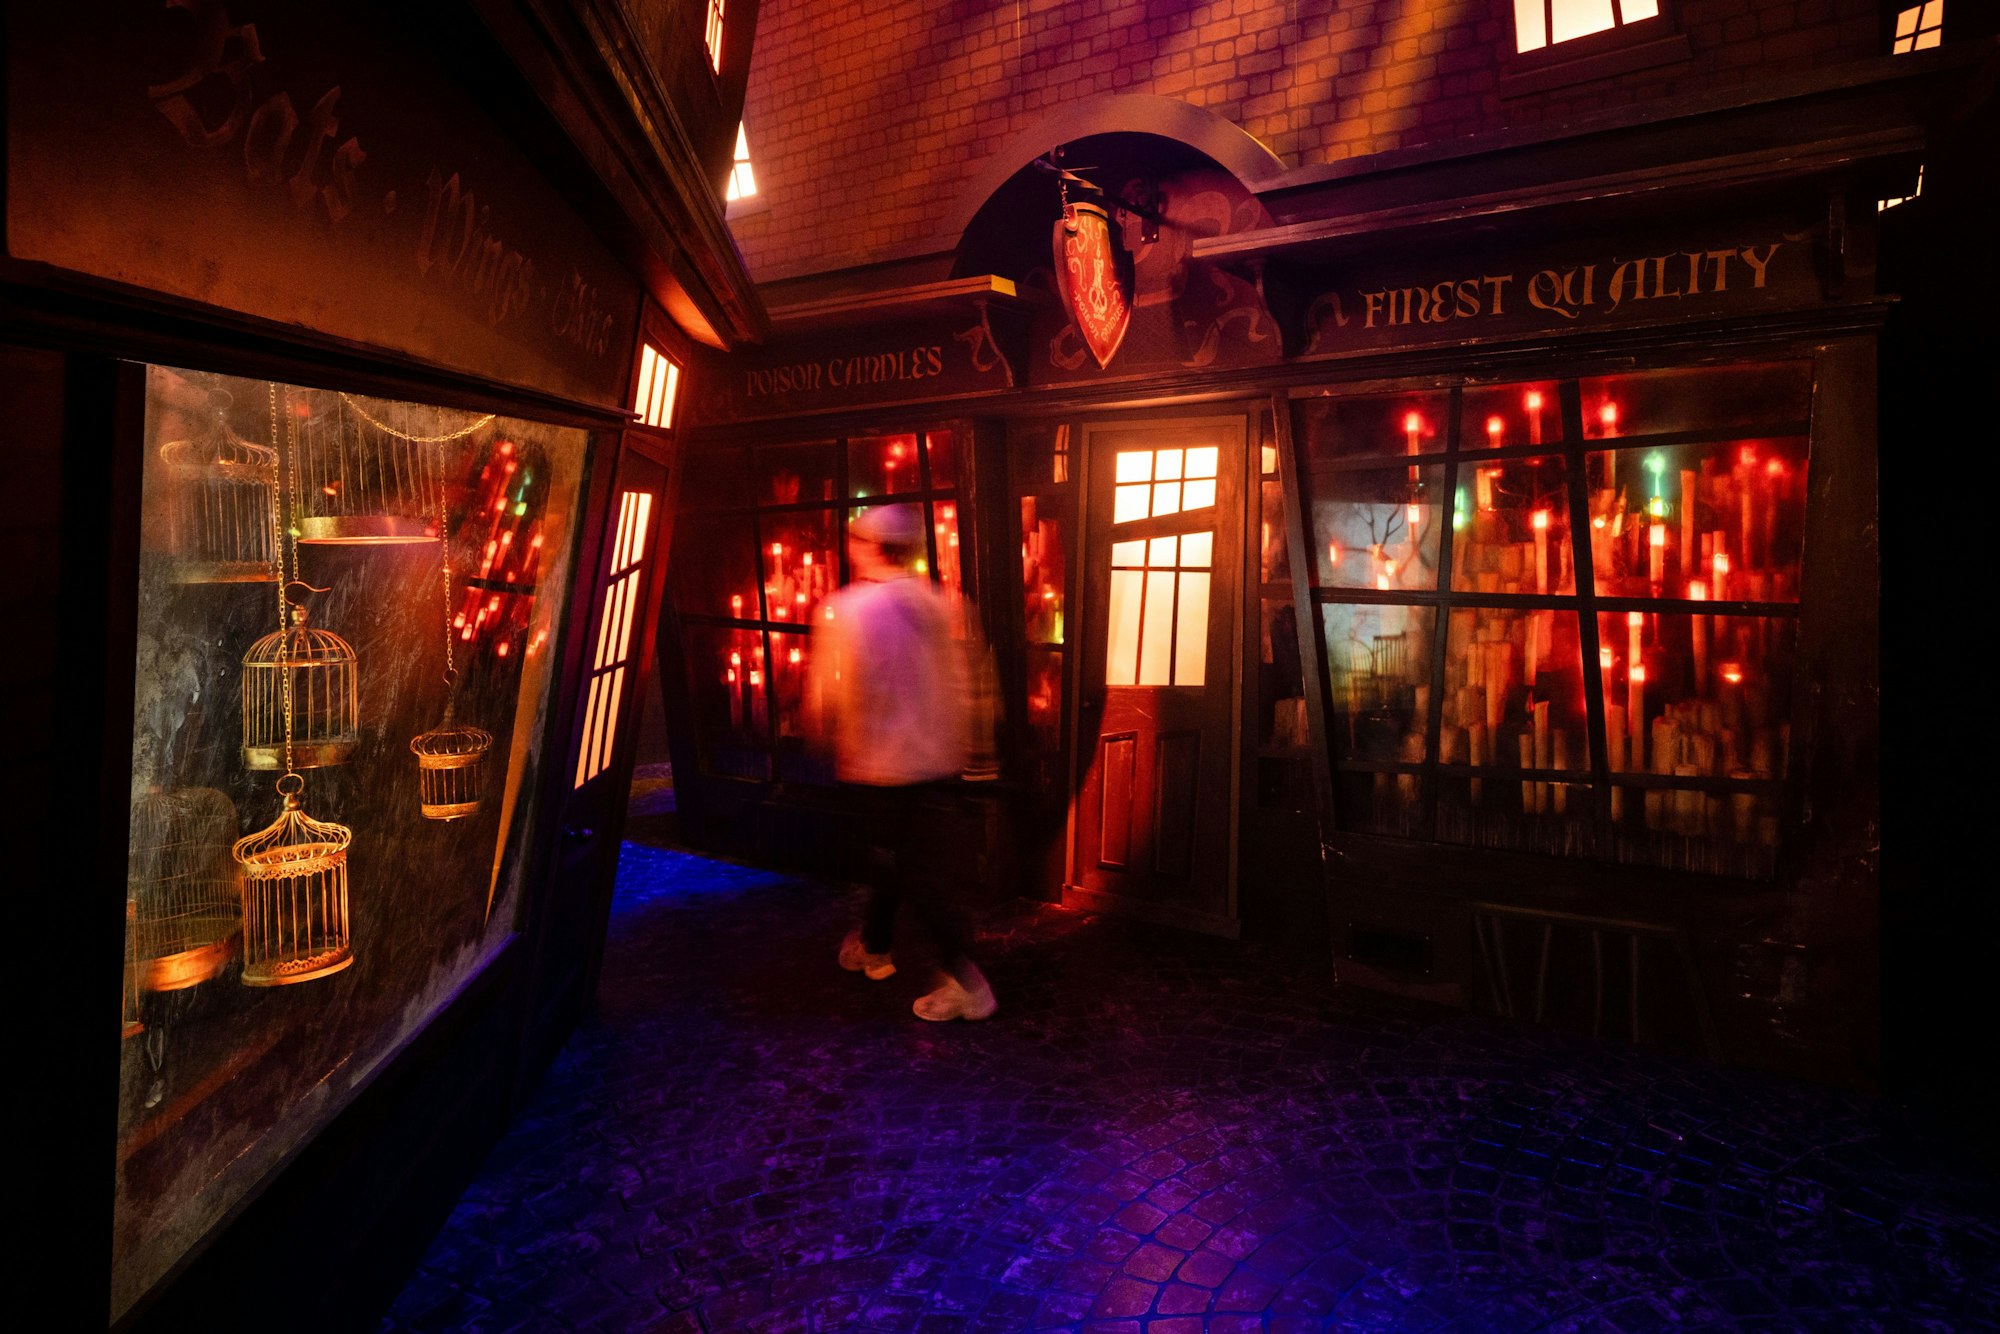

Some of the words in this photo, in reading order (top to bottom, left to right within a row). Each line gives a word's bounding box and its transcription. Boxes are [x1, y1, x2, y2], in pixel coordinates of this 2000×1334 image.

[1358, 273, 1513, 330] FINEST
[745, 362, 823, 397] POISON
[827, 345, 943, 390] CANDLES
